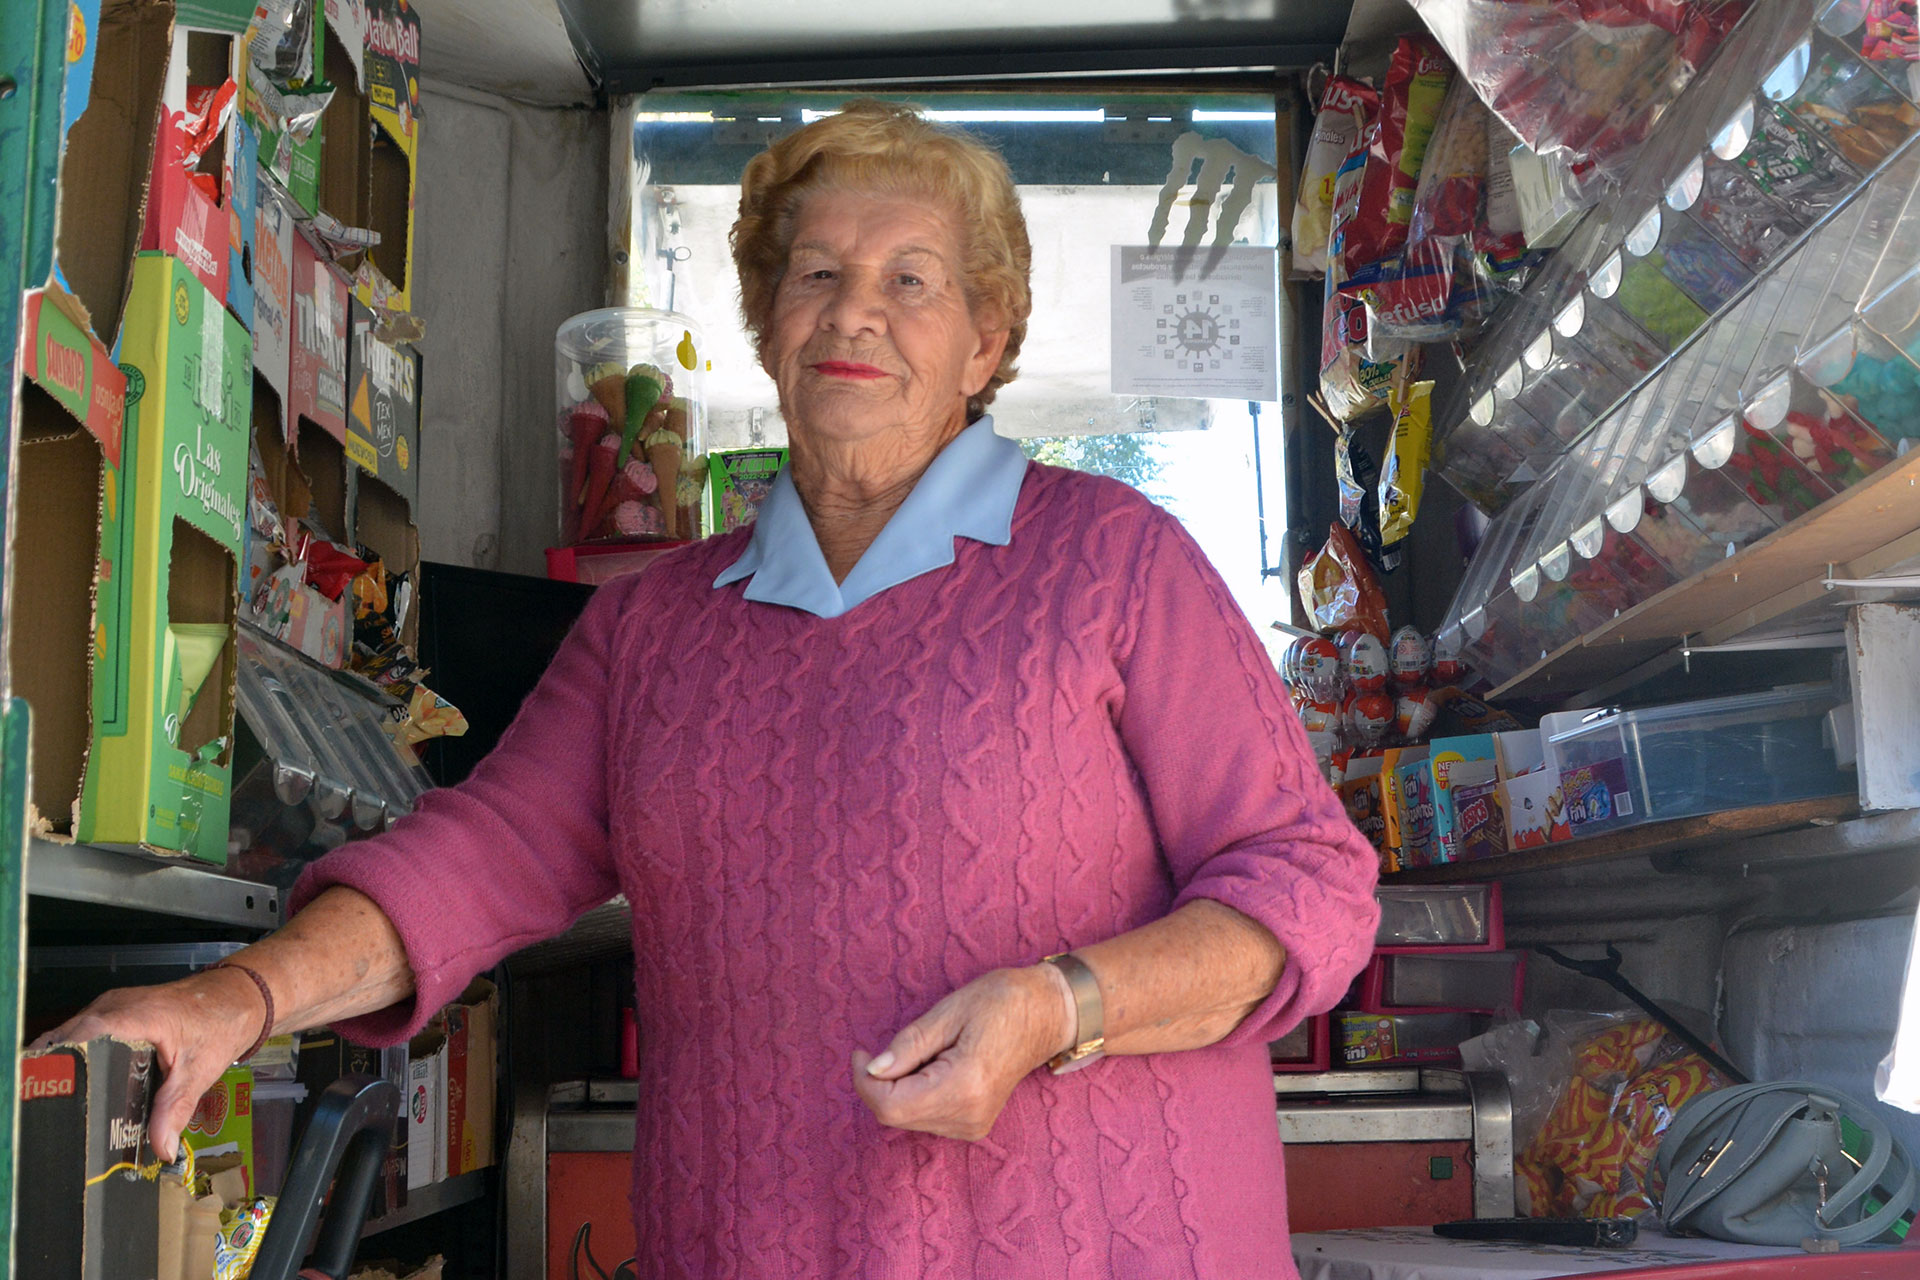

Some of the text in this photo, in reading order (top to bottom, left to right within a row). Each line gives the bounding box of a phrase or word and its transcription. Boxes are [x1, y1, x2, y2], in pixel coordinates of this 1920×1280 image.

[376, 401, 391, 420] TEX
[377, 422, 392, 444] MEX
[196, 424, 221, 477] Las
[728, 457, 778, 473] LIGA
[174, 443, 241, 542] Originales
